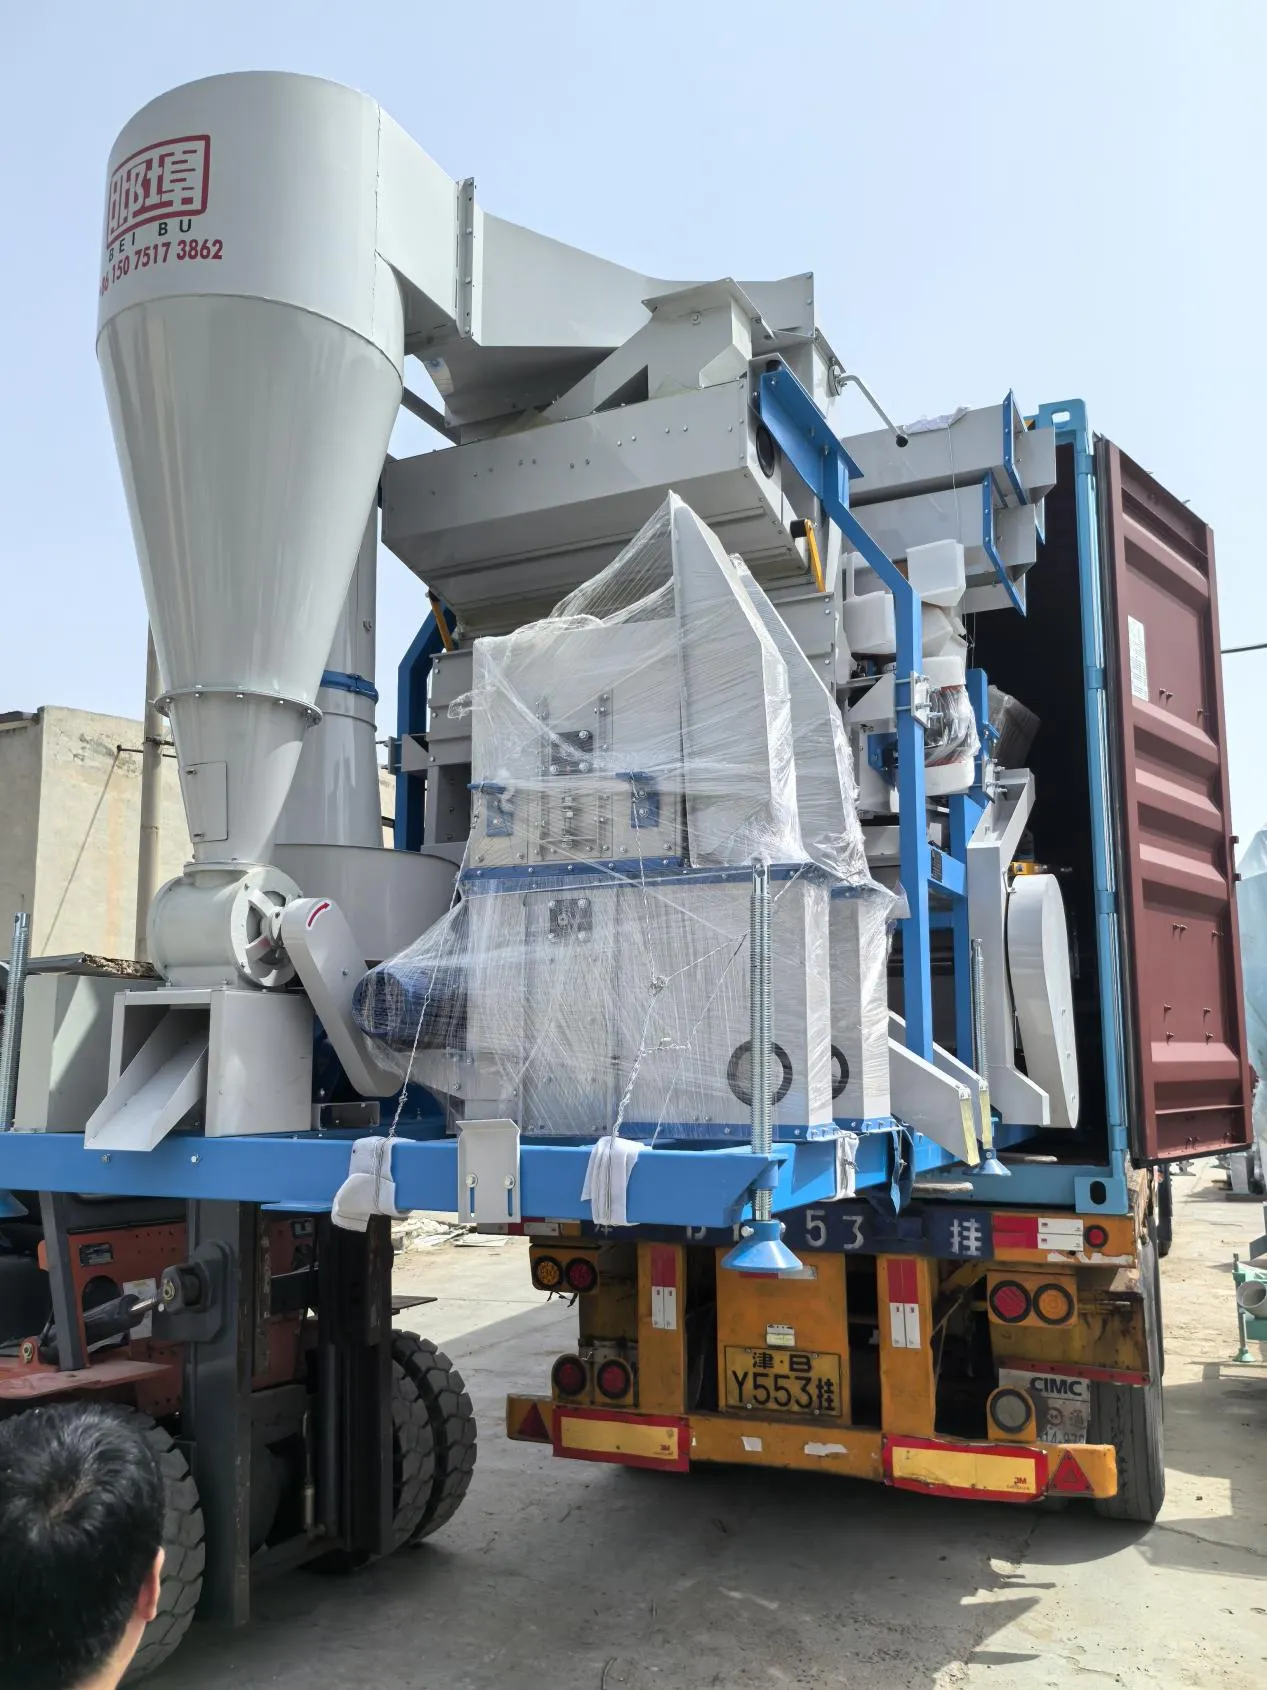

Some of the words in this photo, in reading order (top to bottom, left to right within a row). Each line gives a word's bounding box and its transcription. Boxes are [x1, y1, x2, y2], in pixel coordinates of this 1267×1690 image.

[108, 231, 135, 263] BEI
[158, 218, 192, 236] BU
[112, 255, 130, 284] 150
[134, 241, 171, 270] 7517
[176, 238, 223, 261] 3862
[1030, 1376, 1082, 1397] CIMC
